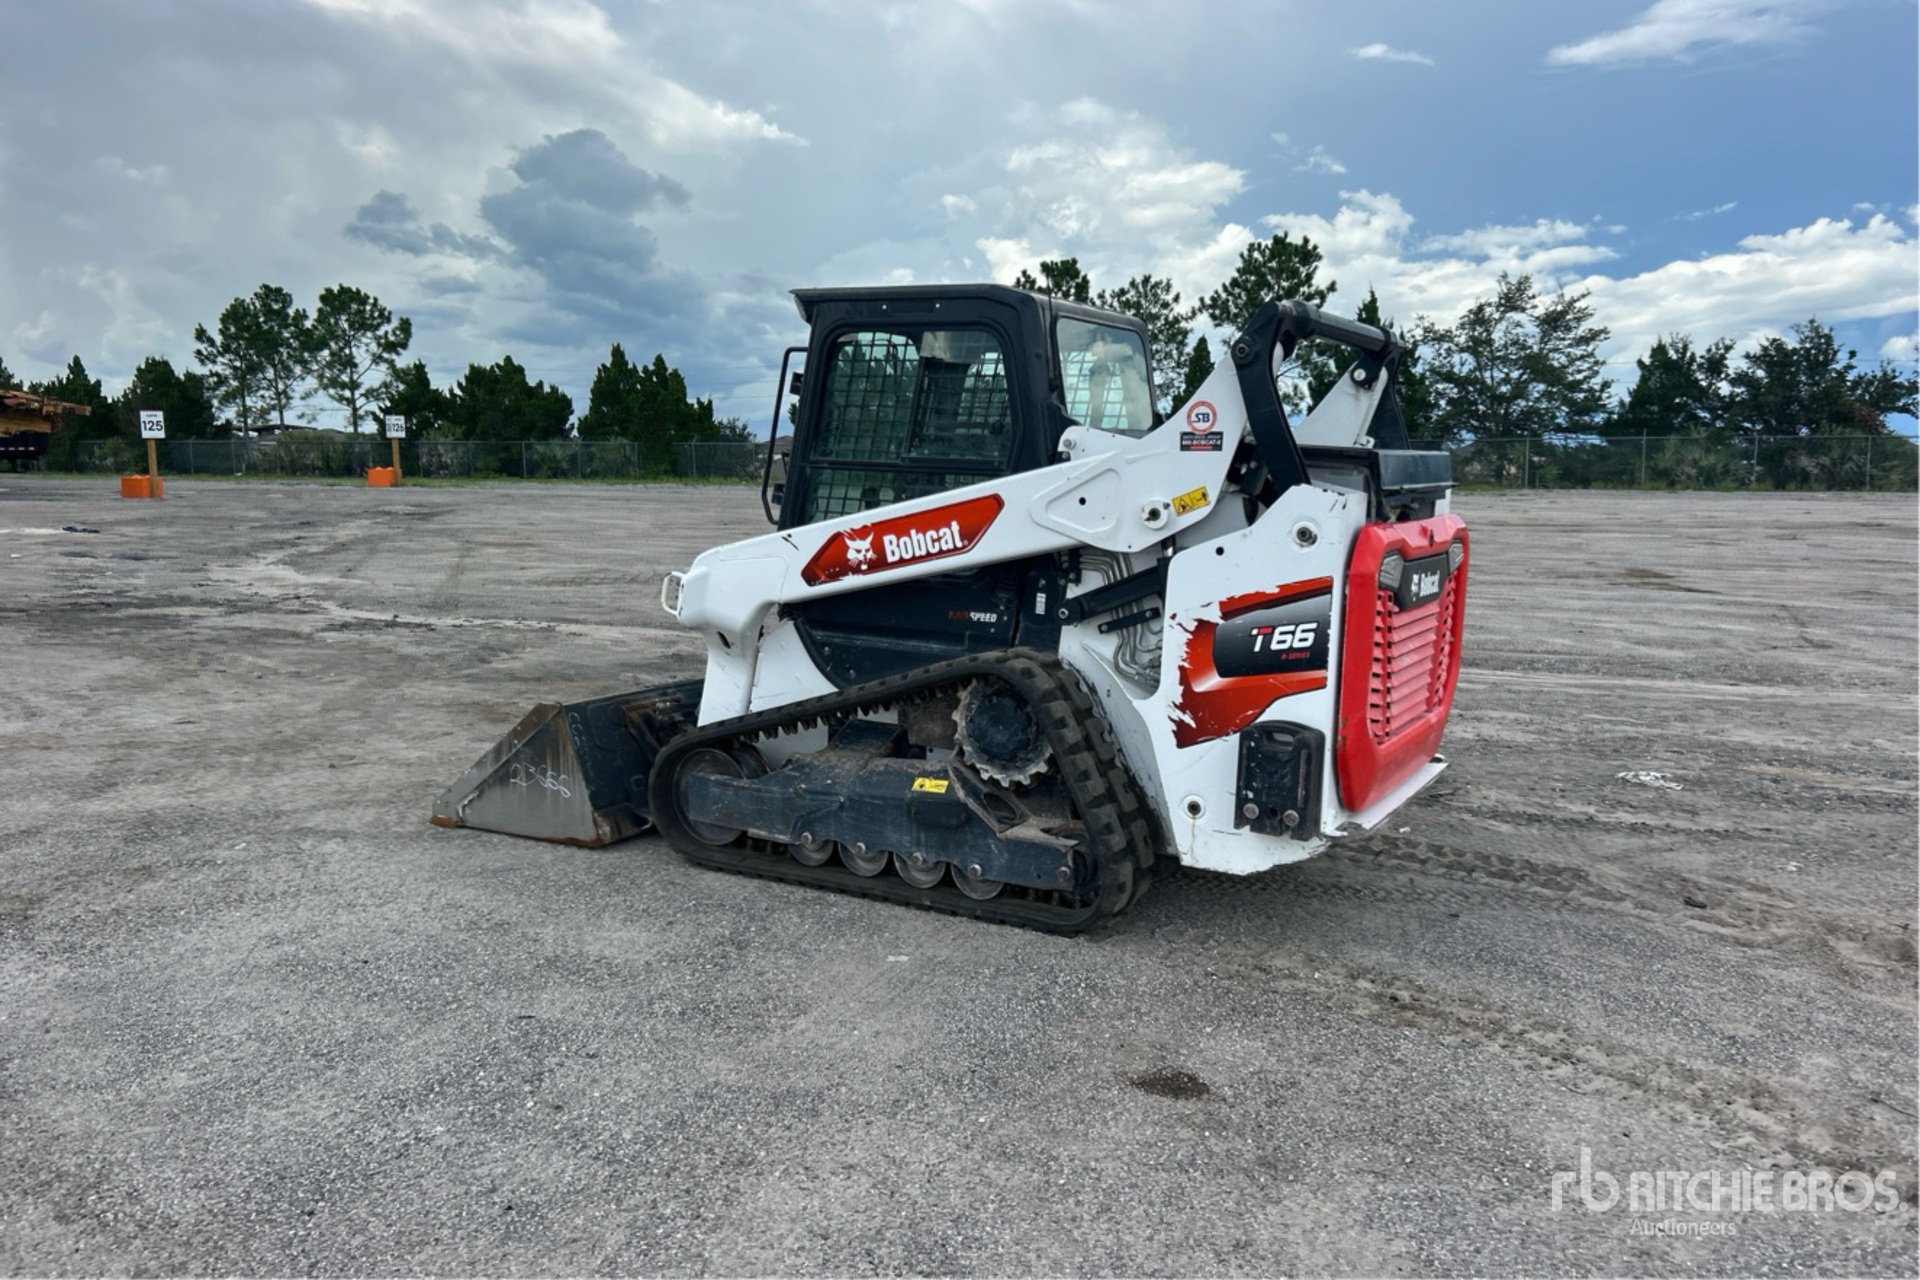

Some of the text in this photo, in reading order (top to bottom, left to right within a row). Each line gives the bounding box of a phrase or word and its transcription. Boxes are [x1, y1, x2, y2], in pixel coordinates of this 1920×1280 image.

[142, 420, 163, 431] 125
[883, 520, 963, 563] Bobcat
[1250, 622, 1319, 653] T66
